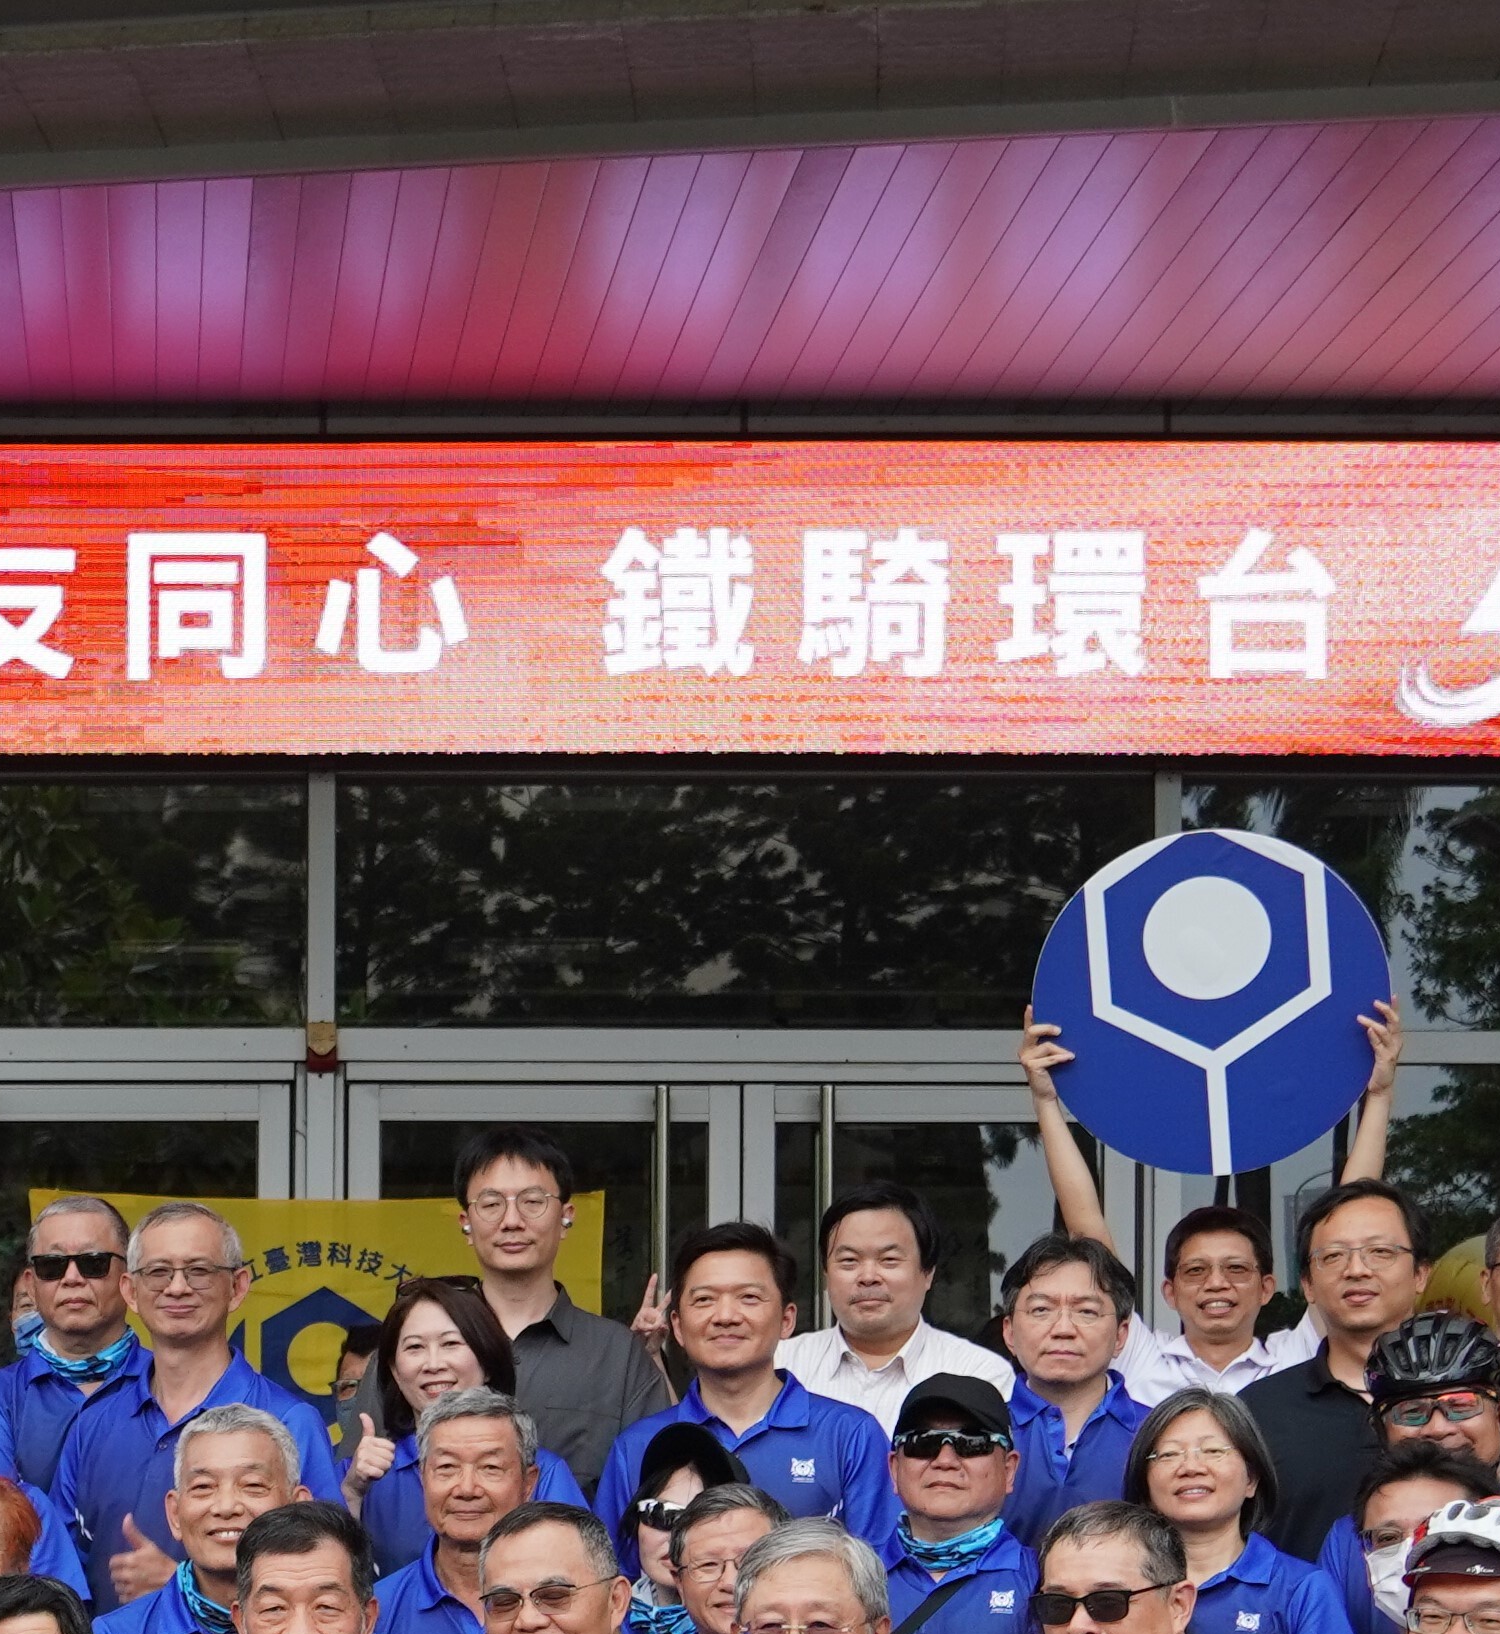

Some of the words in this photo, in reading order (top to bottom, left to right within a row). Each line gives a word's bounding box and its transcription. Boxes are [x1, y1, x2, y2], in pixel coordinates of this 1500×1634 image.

[600, 526, 1334, 683] 鐵騎環台
[242, 1241, 425, 1283] 立臺灣科技大
